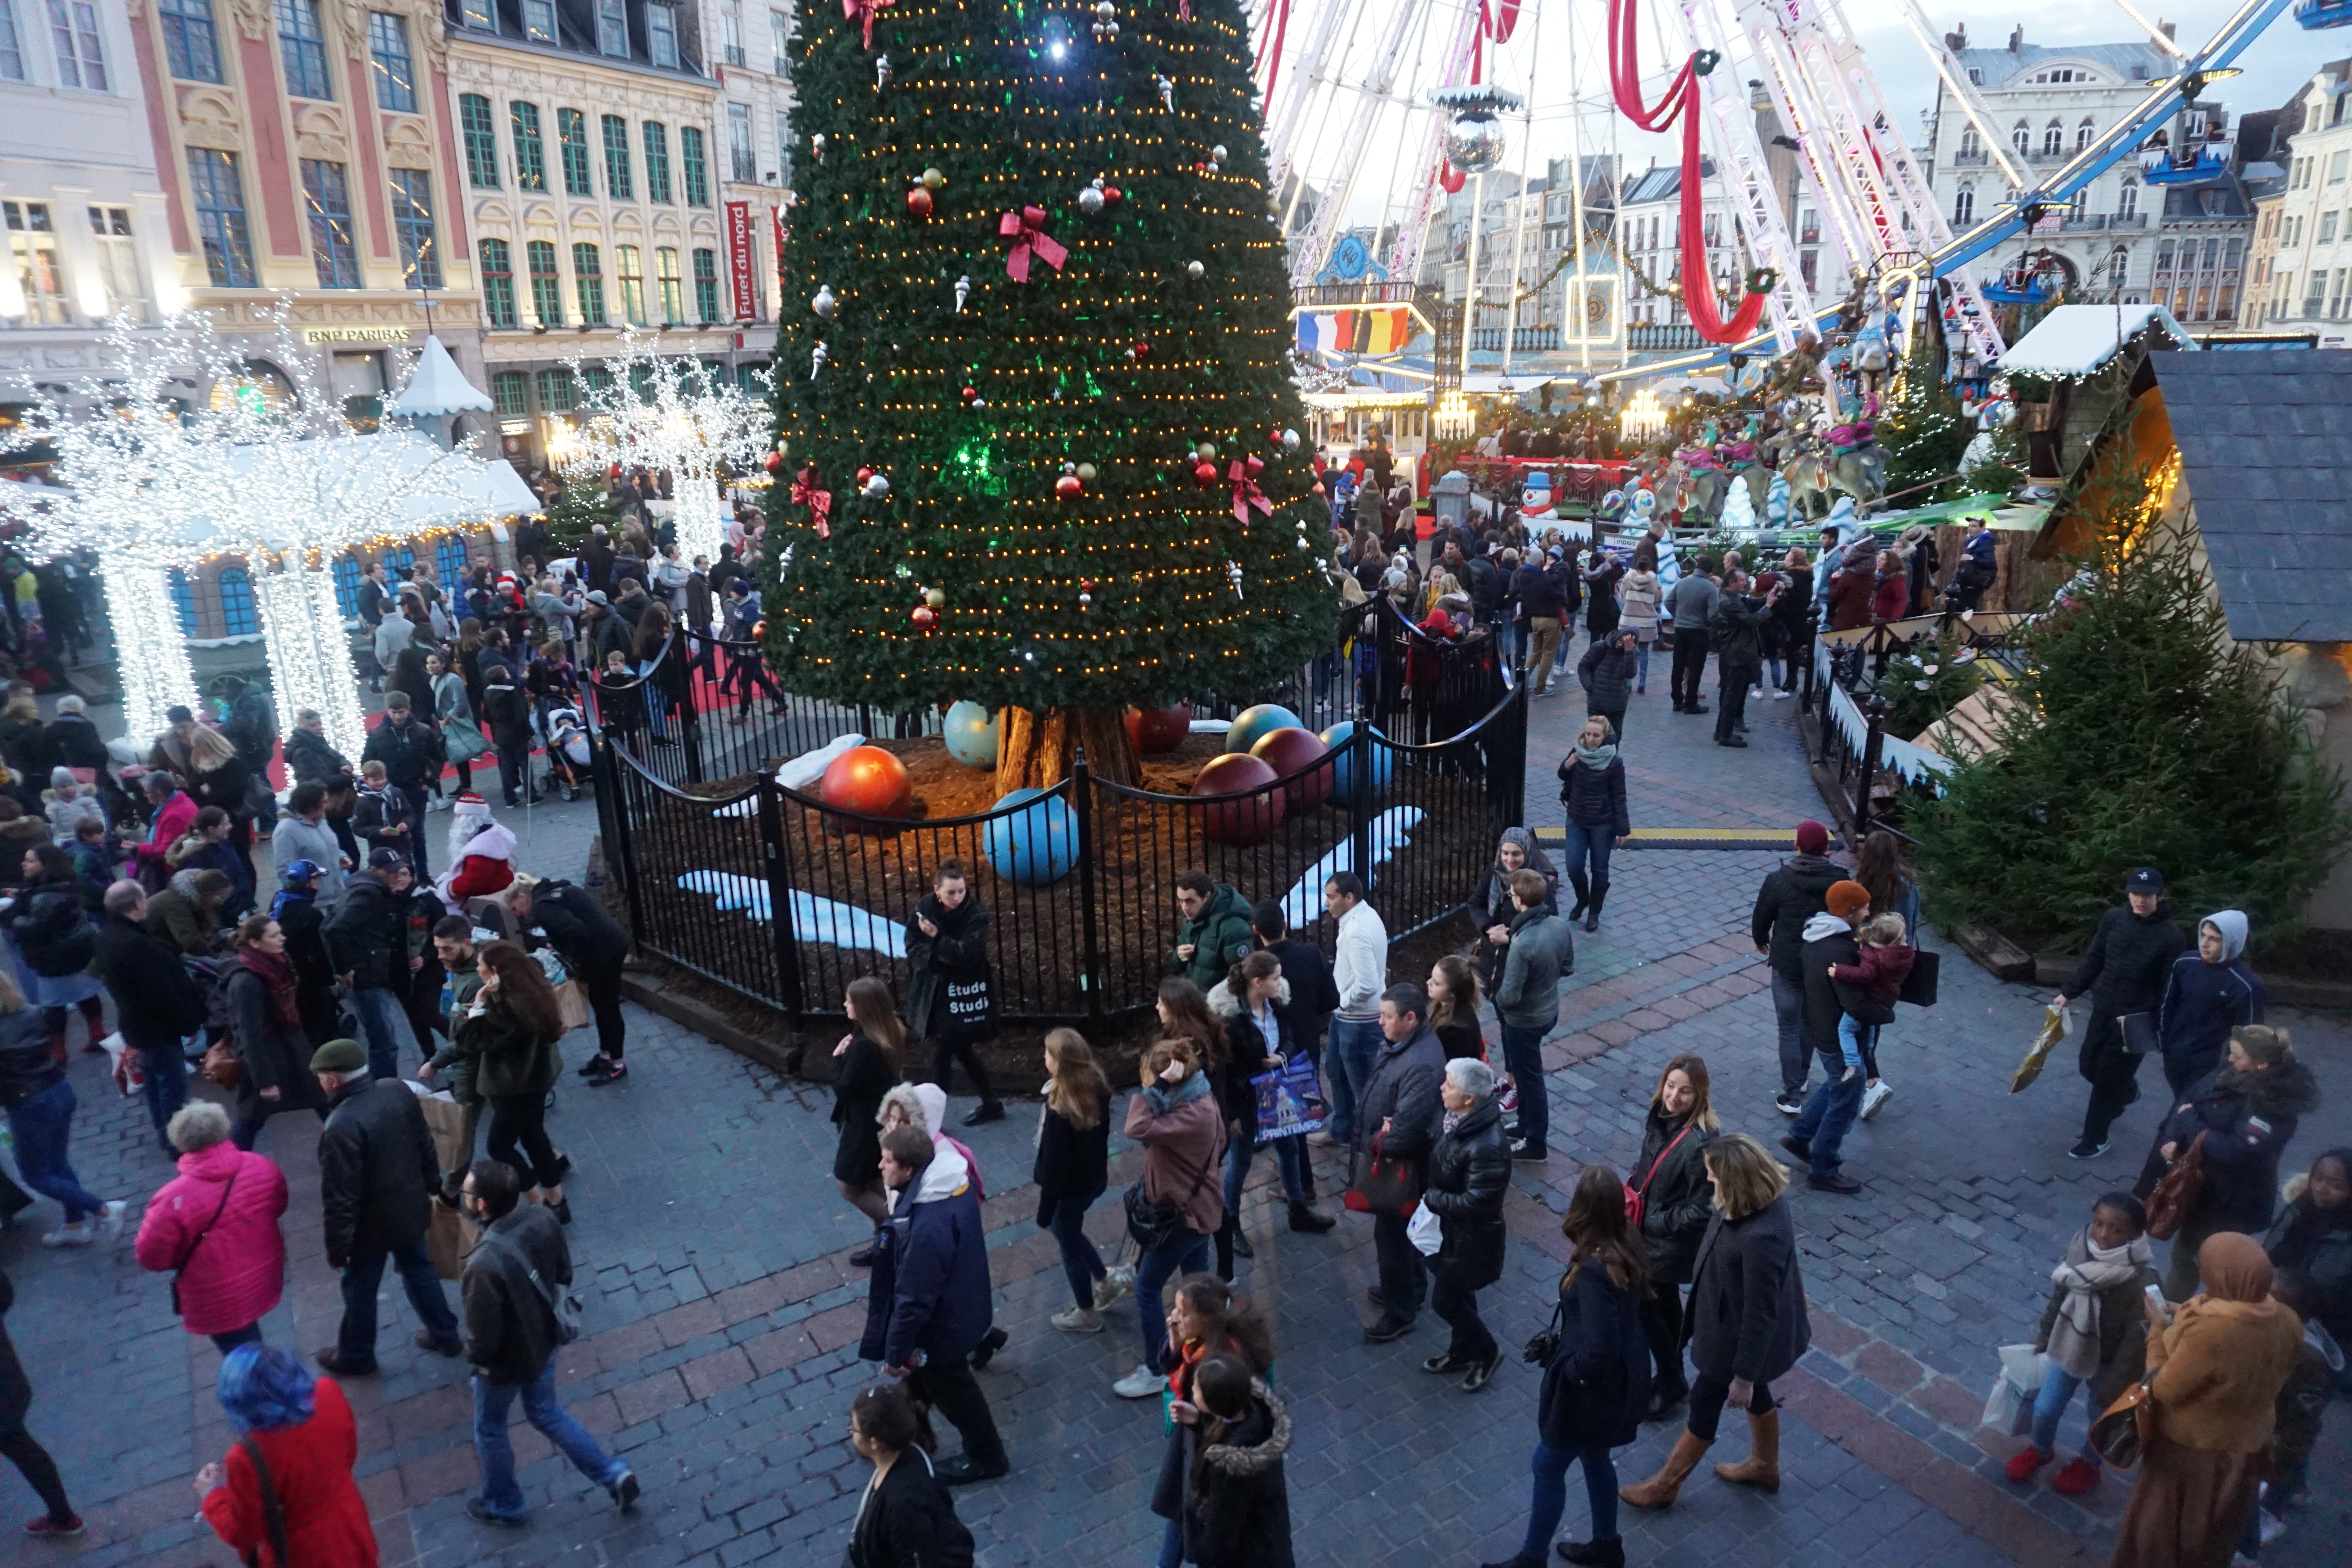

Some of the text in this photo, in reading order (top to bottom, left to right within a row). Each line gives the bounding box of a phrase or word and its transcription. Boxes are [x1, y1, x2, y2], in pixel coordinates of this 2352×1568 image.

[732, 207, 751, 315] Furet du nord
[308, 329, 411, 343] BNP PARIBAS
[1262, 1119, 1322, 1140] PRINTEMPS
